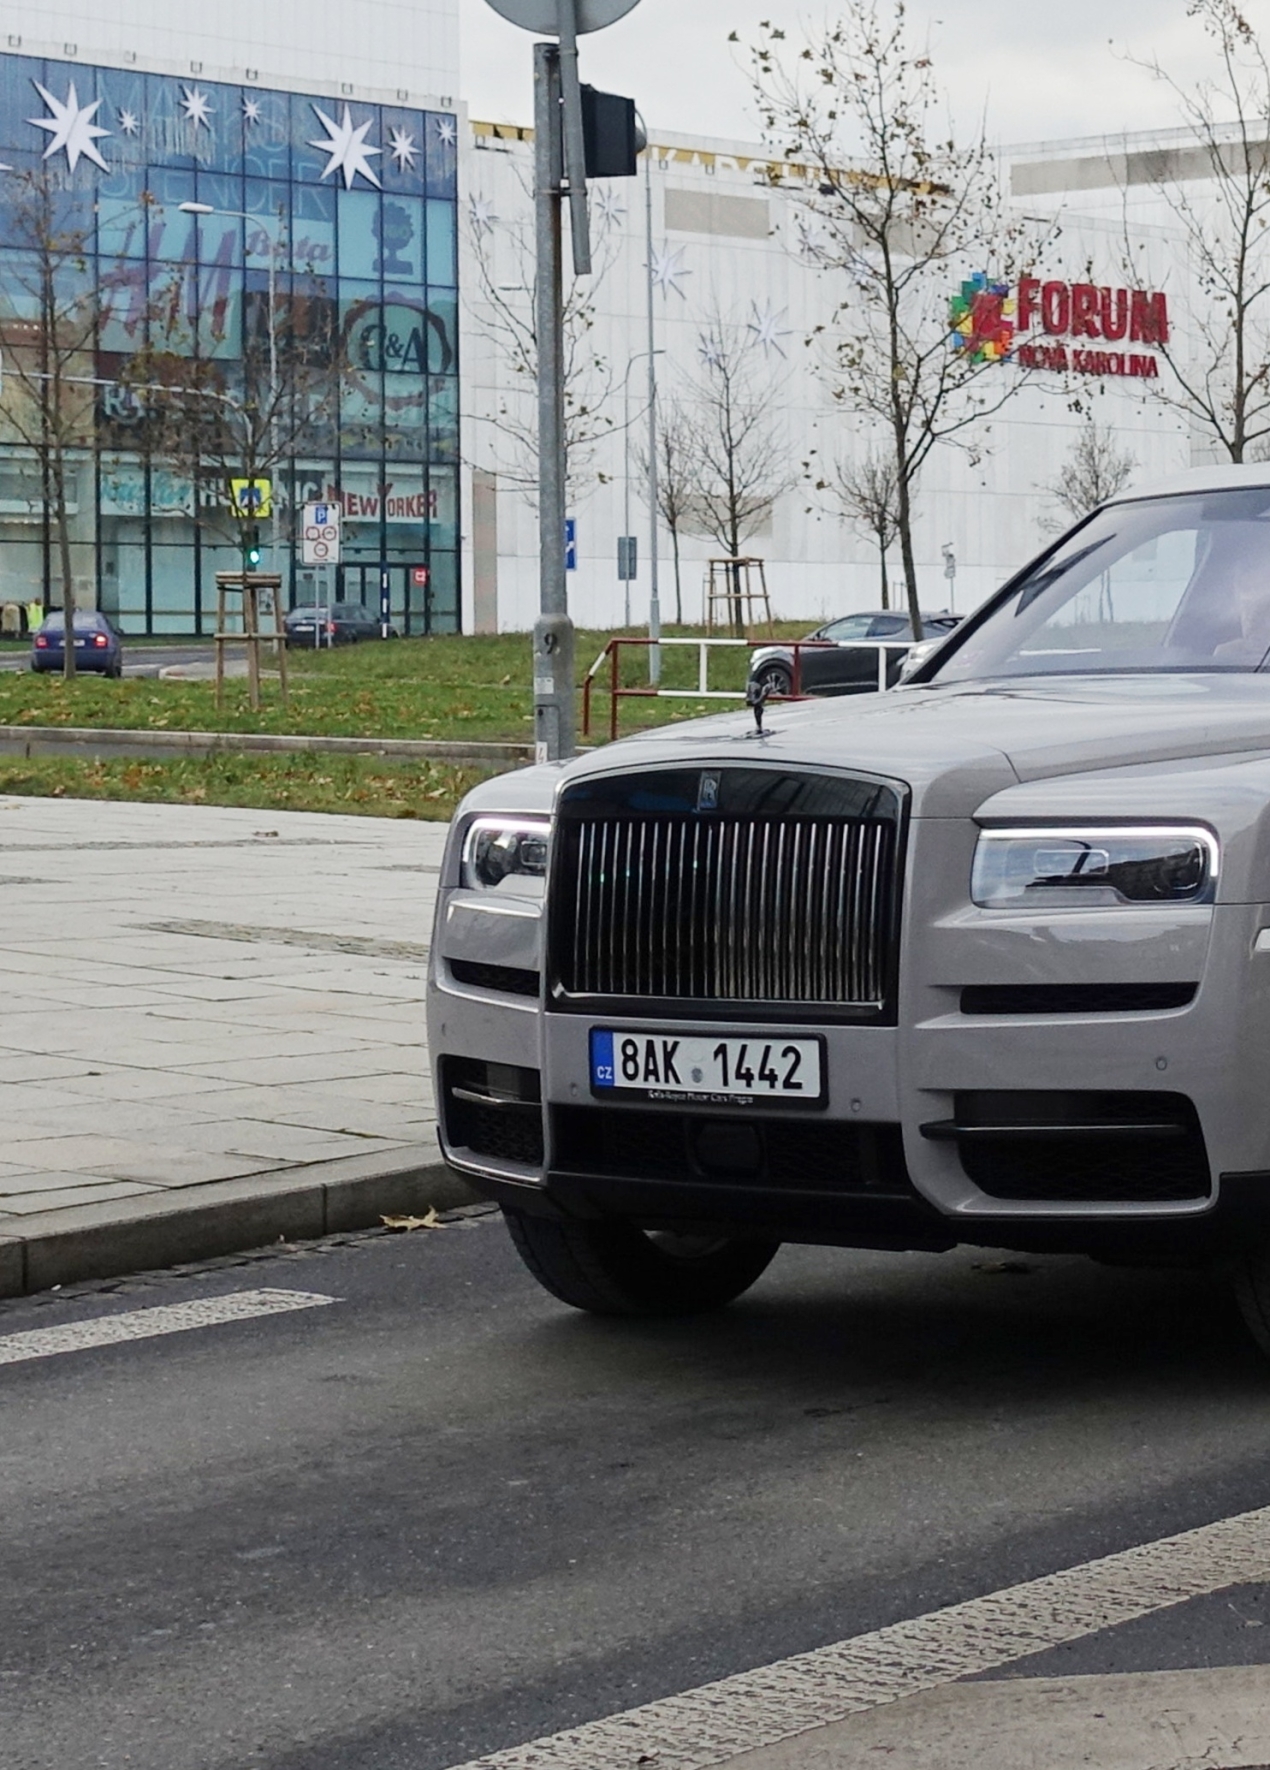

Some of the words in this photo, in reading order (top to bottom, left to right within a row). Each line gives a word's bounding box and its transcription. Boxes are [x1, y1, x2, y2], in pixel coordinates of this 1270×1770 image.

[1018, 278, 1169, 344] FORUM
[361, 324, 428, 372] C&A
[1072, 350, 1158, 378] KAROLINA
[597, 1065, 612, 1080] CZ
[621, 1038, 682, 1085] 8AK
[713, 1043, 803, 1091] 1442
